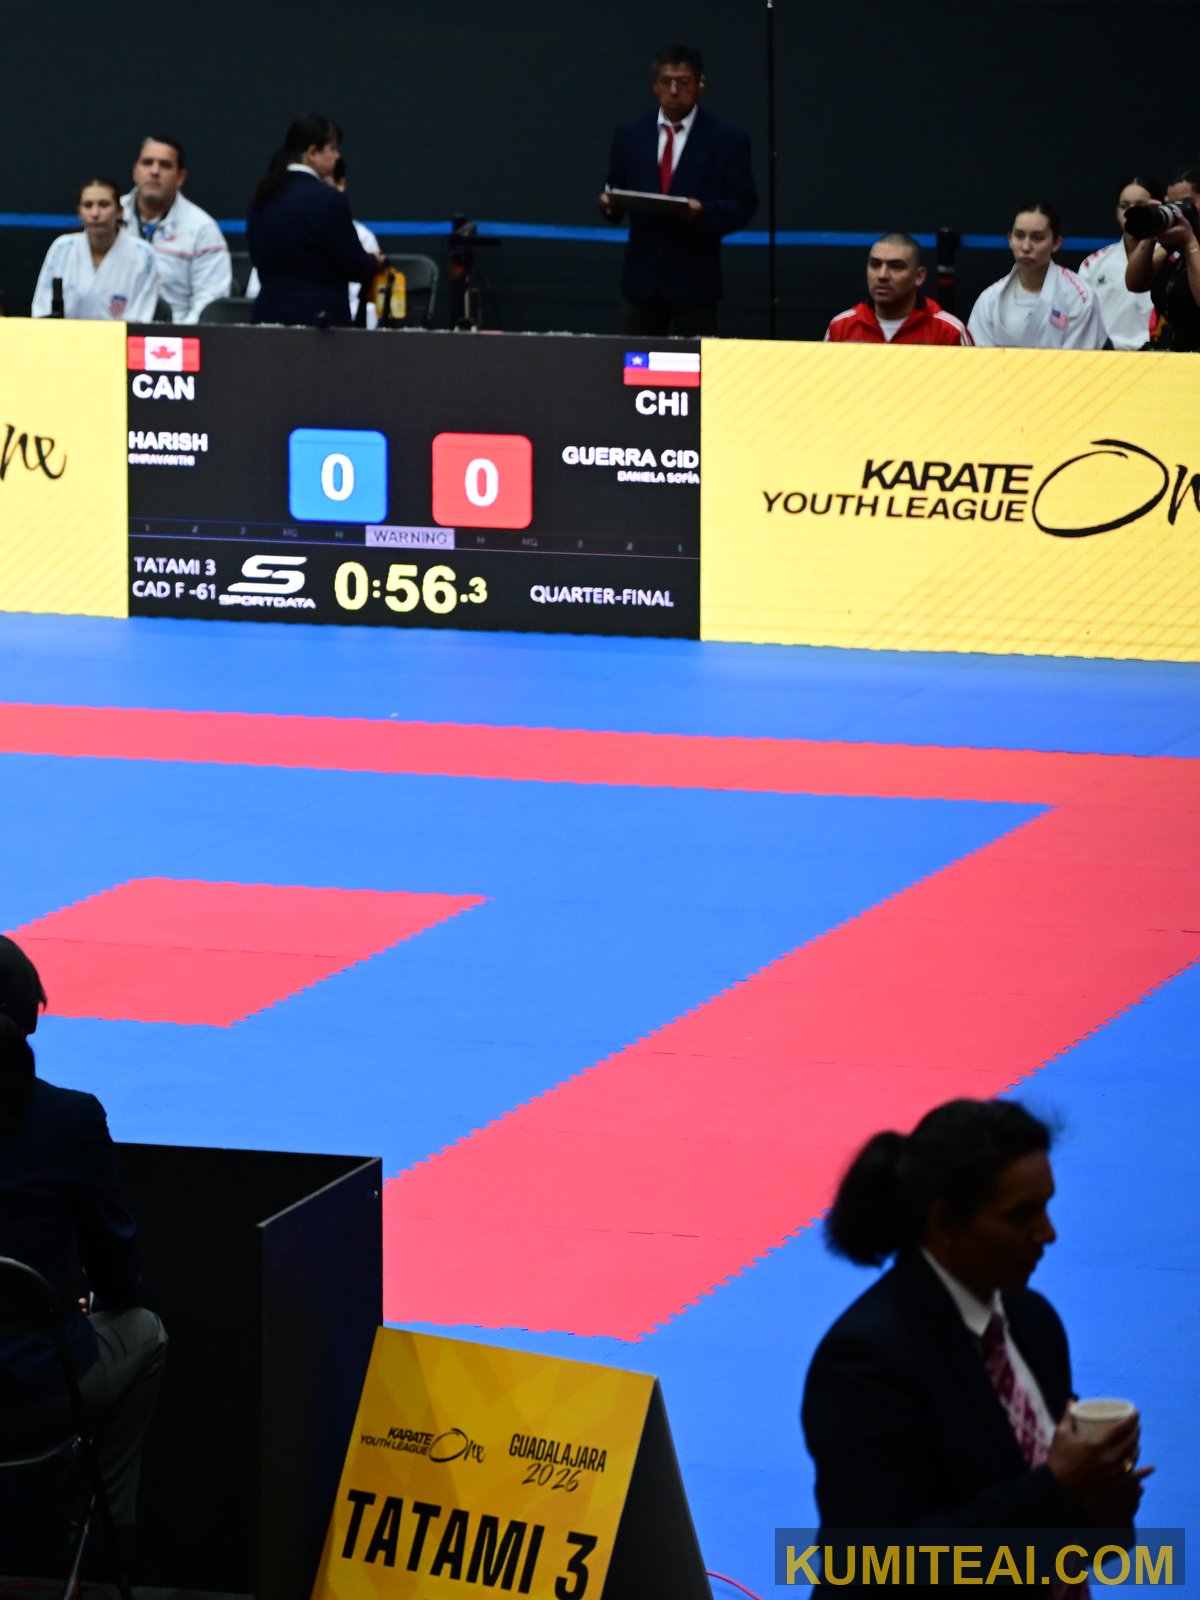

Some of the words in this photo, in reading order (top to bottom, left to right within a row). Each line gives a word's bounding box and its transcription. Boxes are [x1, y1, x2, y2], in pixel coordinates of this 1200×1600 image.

[132, 373, 195, 401] CAN
[635, 389, 689, 417] CHI
[128, 431, 209, 452] HARISH
[561, 445, 657, 468] GUERRA
[661, 449, 700, 469] CID
[321, 453, 355, 502] 0
[464, 458, 499, 507] 0
[862, 459, 1034, 494] KARATE
[762, 491, 878, 517] YOUTH
[885, 496, 1028, 522] LEAGUE
[373, 529, 448, 545] WARNING
[133, 555, 200, 576] TATAMI
[204, 558, 217, 577] 3
[132, 580, 171, 598] CAD
[175, 581, 185, 600] F
[188, 582, 217, 601] -61
[218, 593, 317, 609] SPORTDATA
[530, 584, 675, 608] QUARTER-FINAL
[360, 1433, 391, 1449] YOUTH
[391, 1440, 430, 1456] LEAGUE
[387, 1426, 435, 1446] KARATE
[428, 1427, 487, 1464] One
[509, 1433, 608, 1473] GUADALAJARA
[521, 1462, 582, 1492] 2026
[341, 1488, 545, 1594] TATAMI
[554, 1530, 599, 1600] 3
